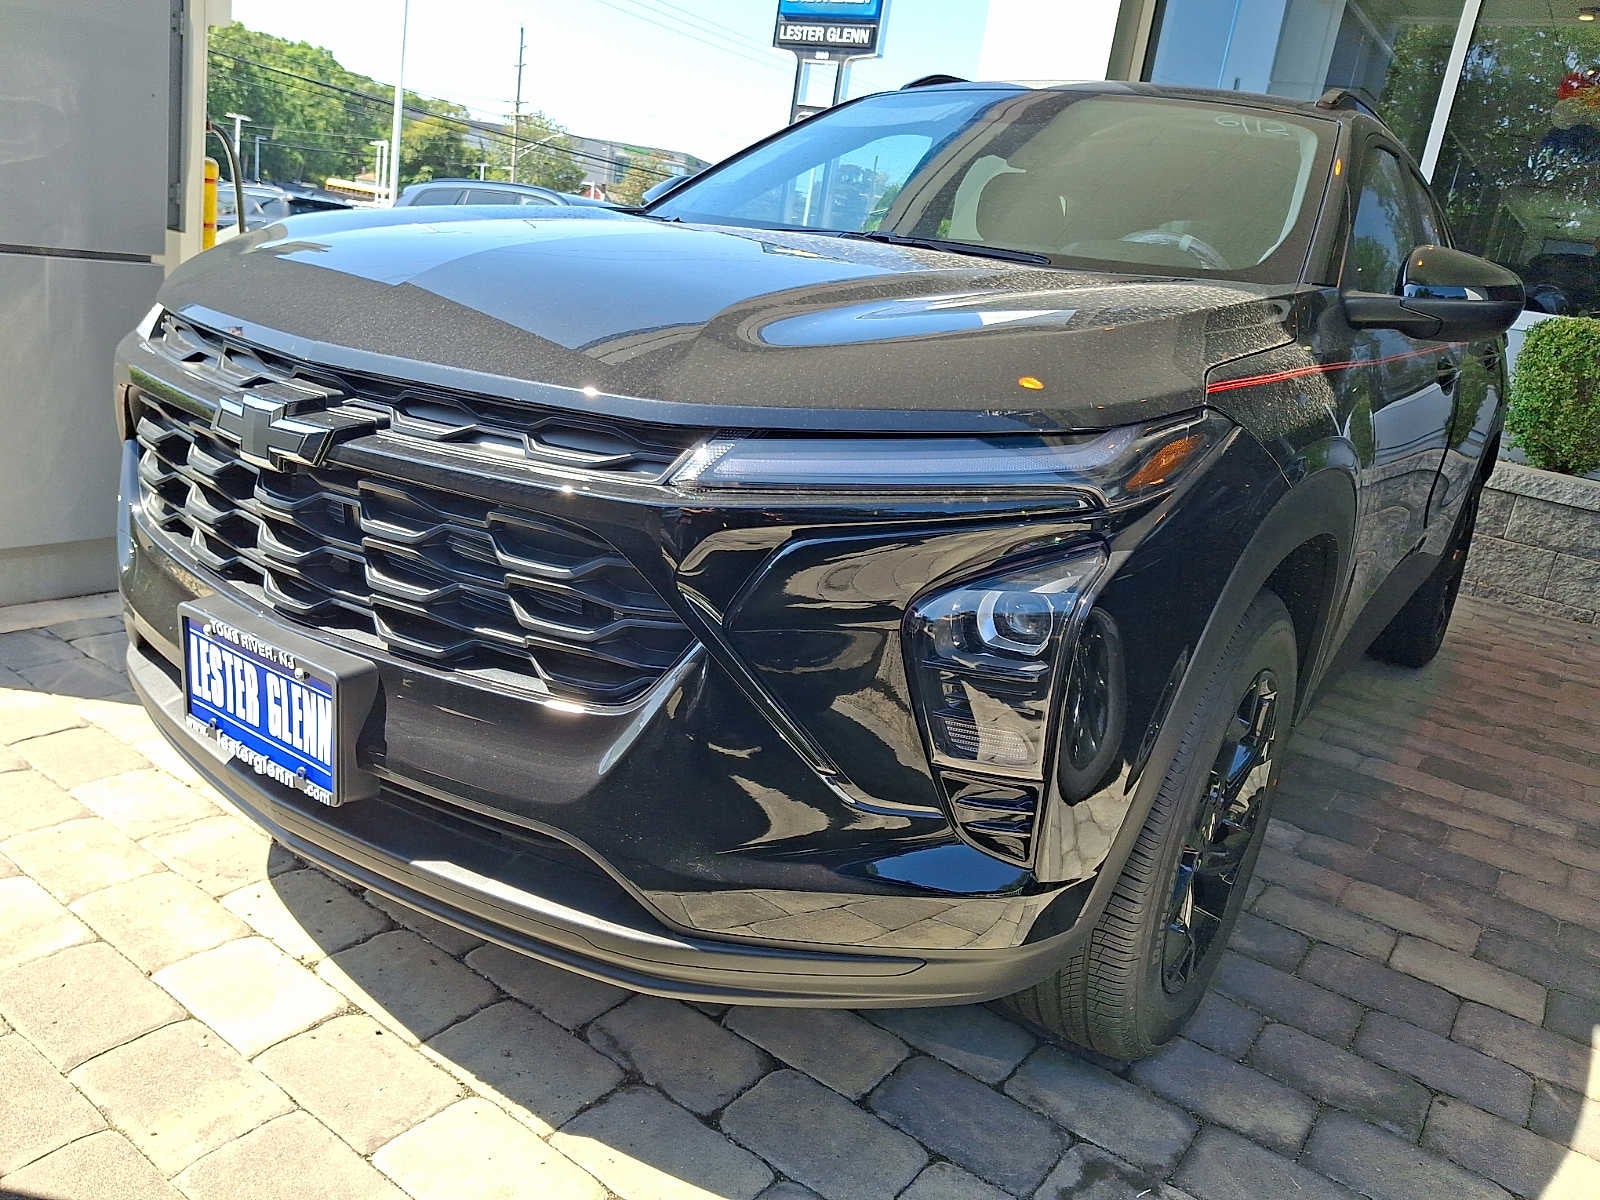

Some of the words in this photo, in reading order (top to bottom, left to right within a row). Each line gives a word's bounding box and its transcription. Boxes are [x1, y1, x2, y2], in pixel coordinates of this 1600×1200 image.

[779, 25, 825, 42] LESTER
[826, 27, 870, 43] GLENN
[209, 619, 240, 645] TOMS
[278, 651, 296, 669] NJ
[190, 633, 260, 728] LESTER
[265, 672, 333, 767] GLENN
